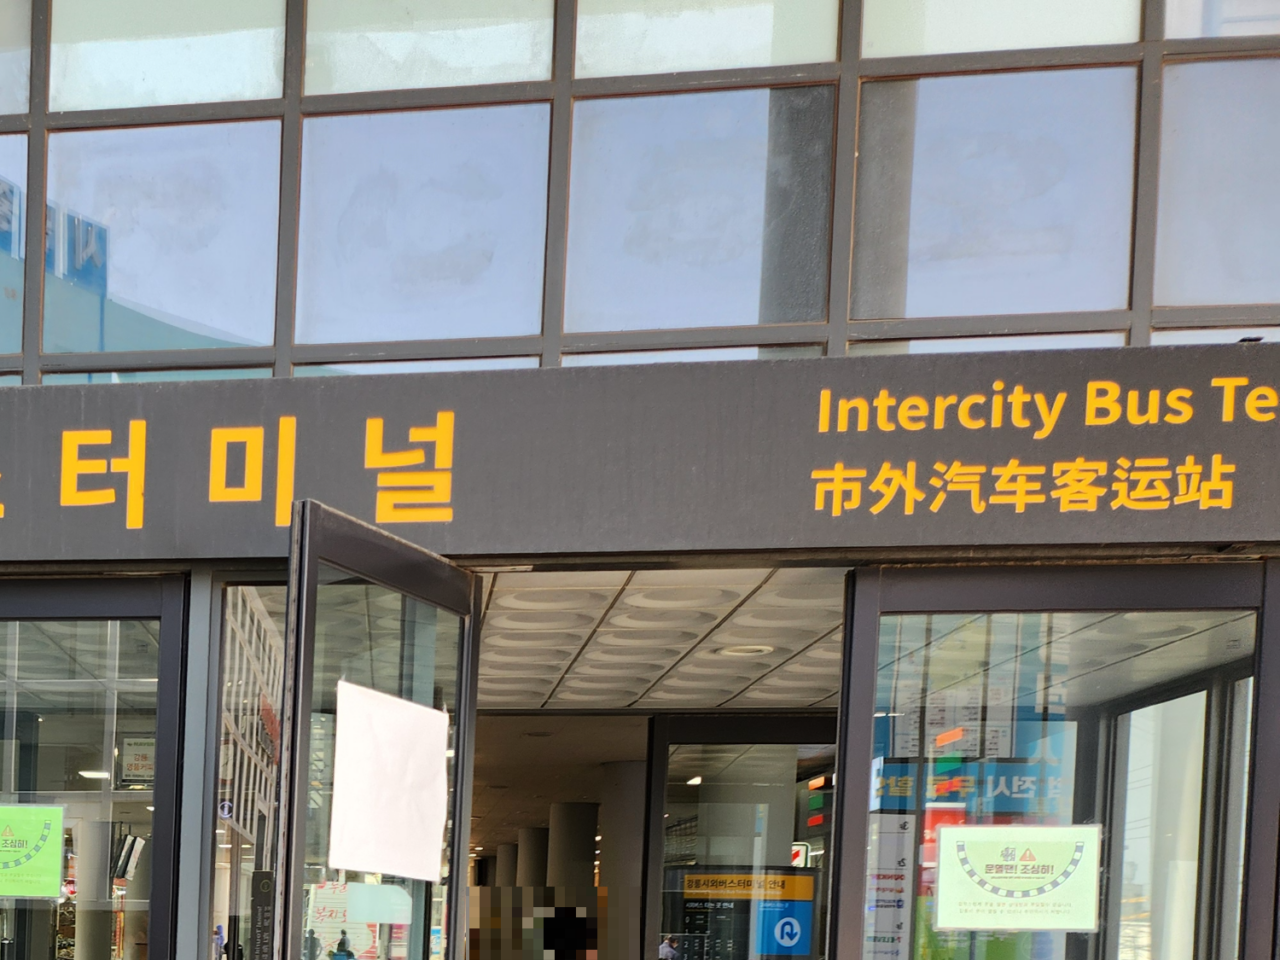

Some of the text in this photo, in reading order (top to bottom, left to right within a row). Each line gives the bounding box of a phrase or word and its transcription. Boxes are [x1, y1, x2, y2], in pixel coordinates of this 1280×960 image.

[818, 380, 1068, 440] Intercity
[1084, 380, 1194, 426] Bus
[811, 454, 1237, 518] 市外汽车客运站
